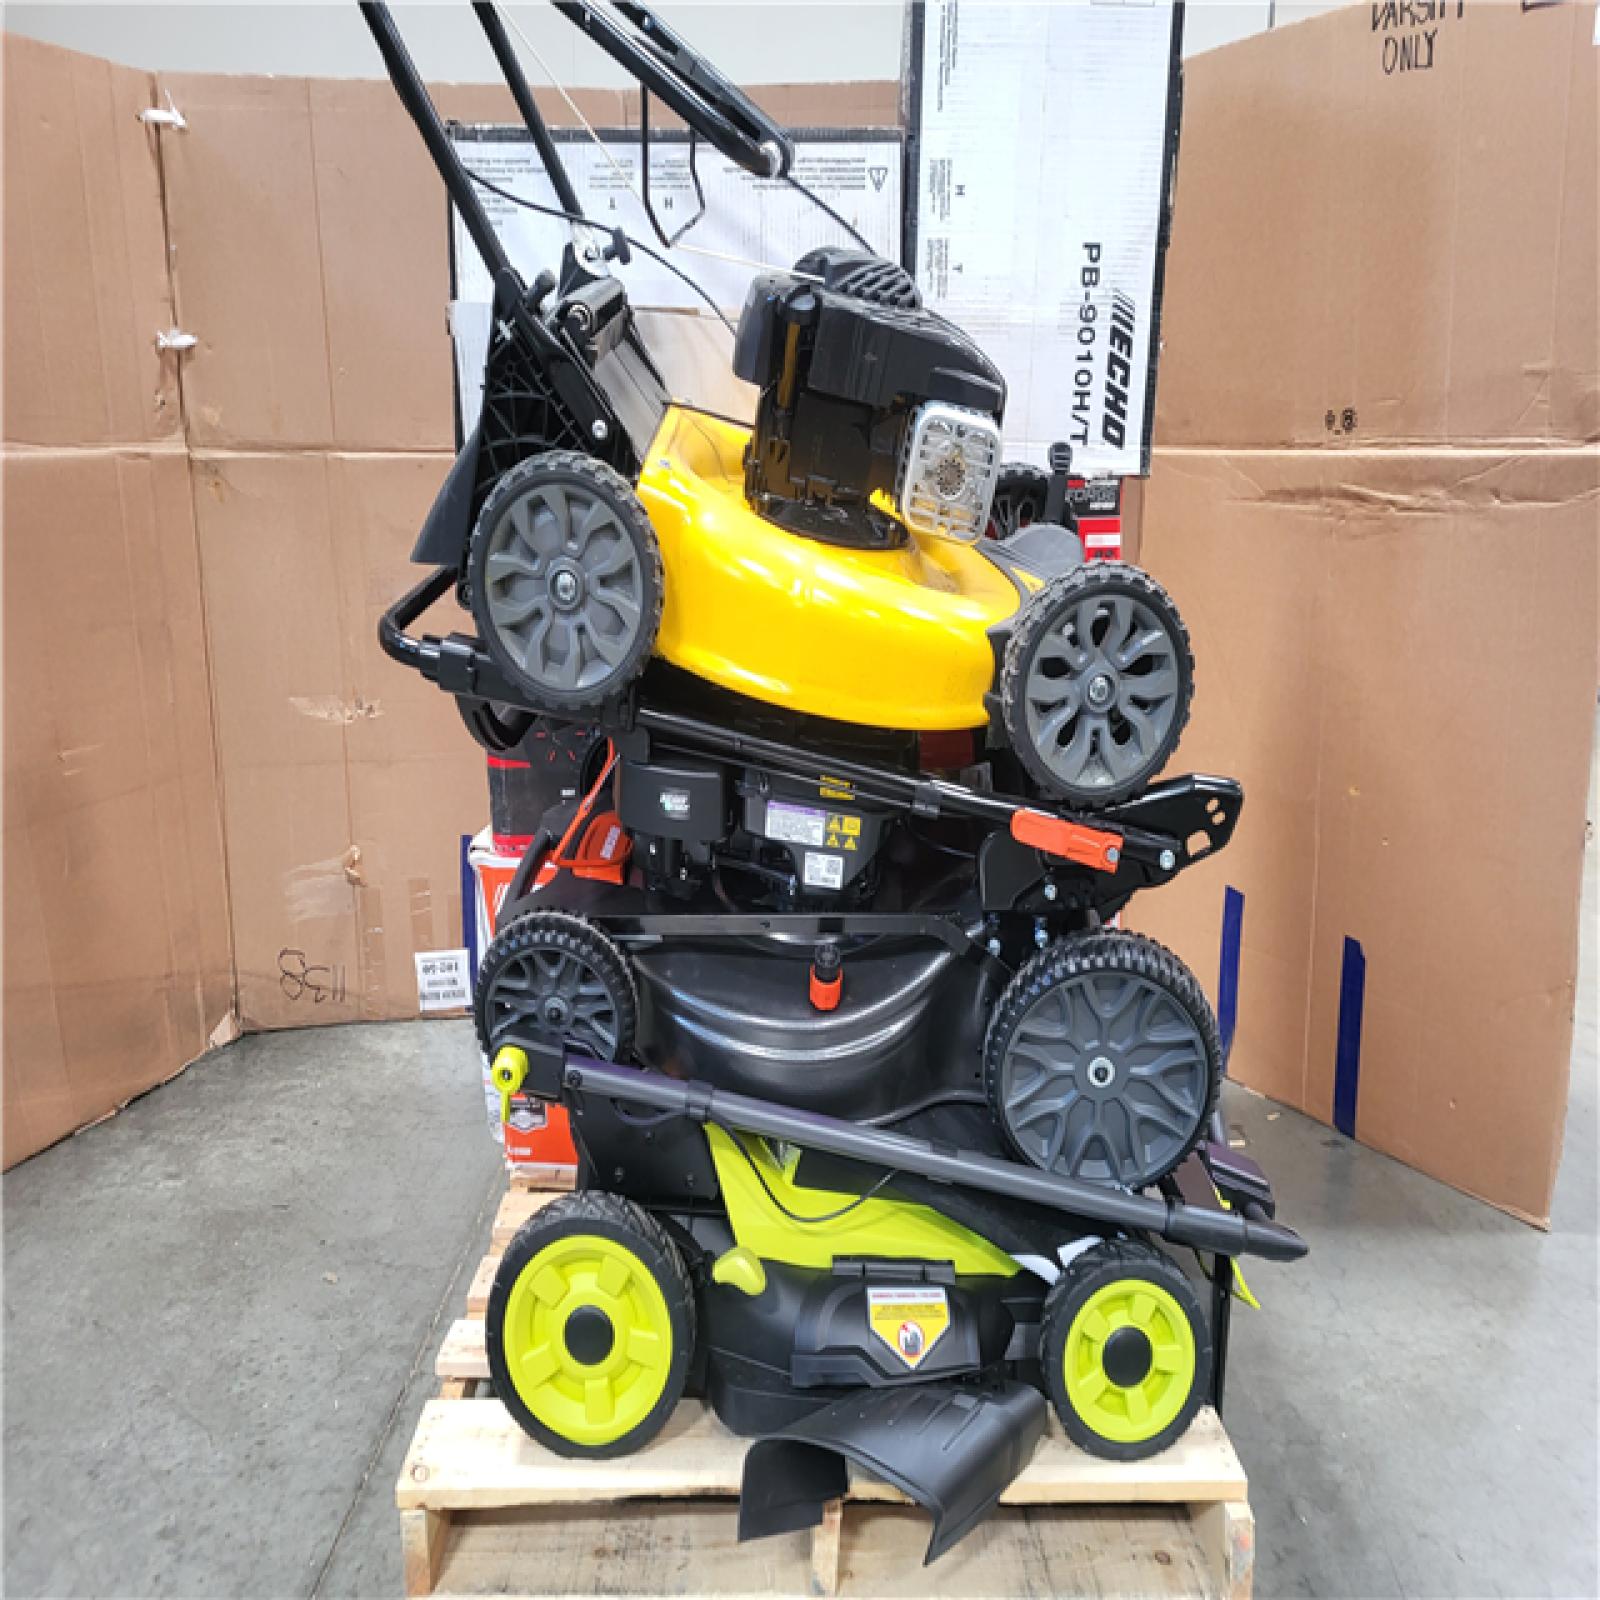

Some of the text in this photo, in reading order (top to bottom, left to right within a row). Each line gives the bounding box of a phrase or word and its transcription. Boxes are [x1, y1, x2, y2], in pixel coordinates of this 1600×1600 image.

[1382, 28, 1438, 75] ONLY
[1070, 242, 1102, 446] PB-9010H/T
[1101, 323, 1136, 451] ECHO
